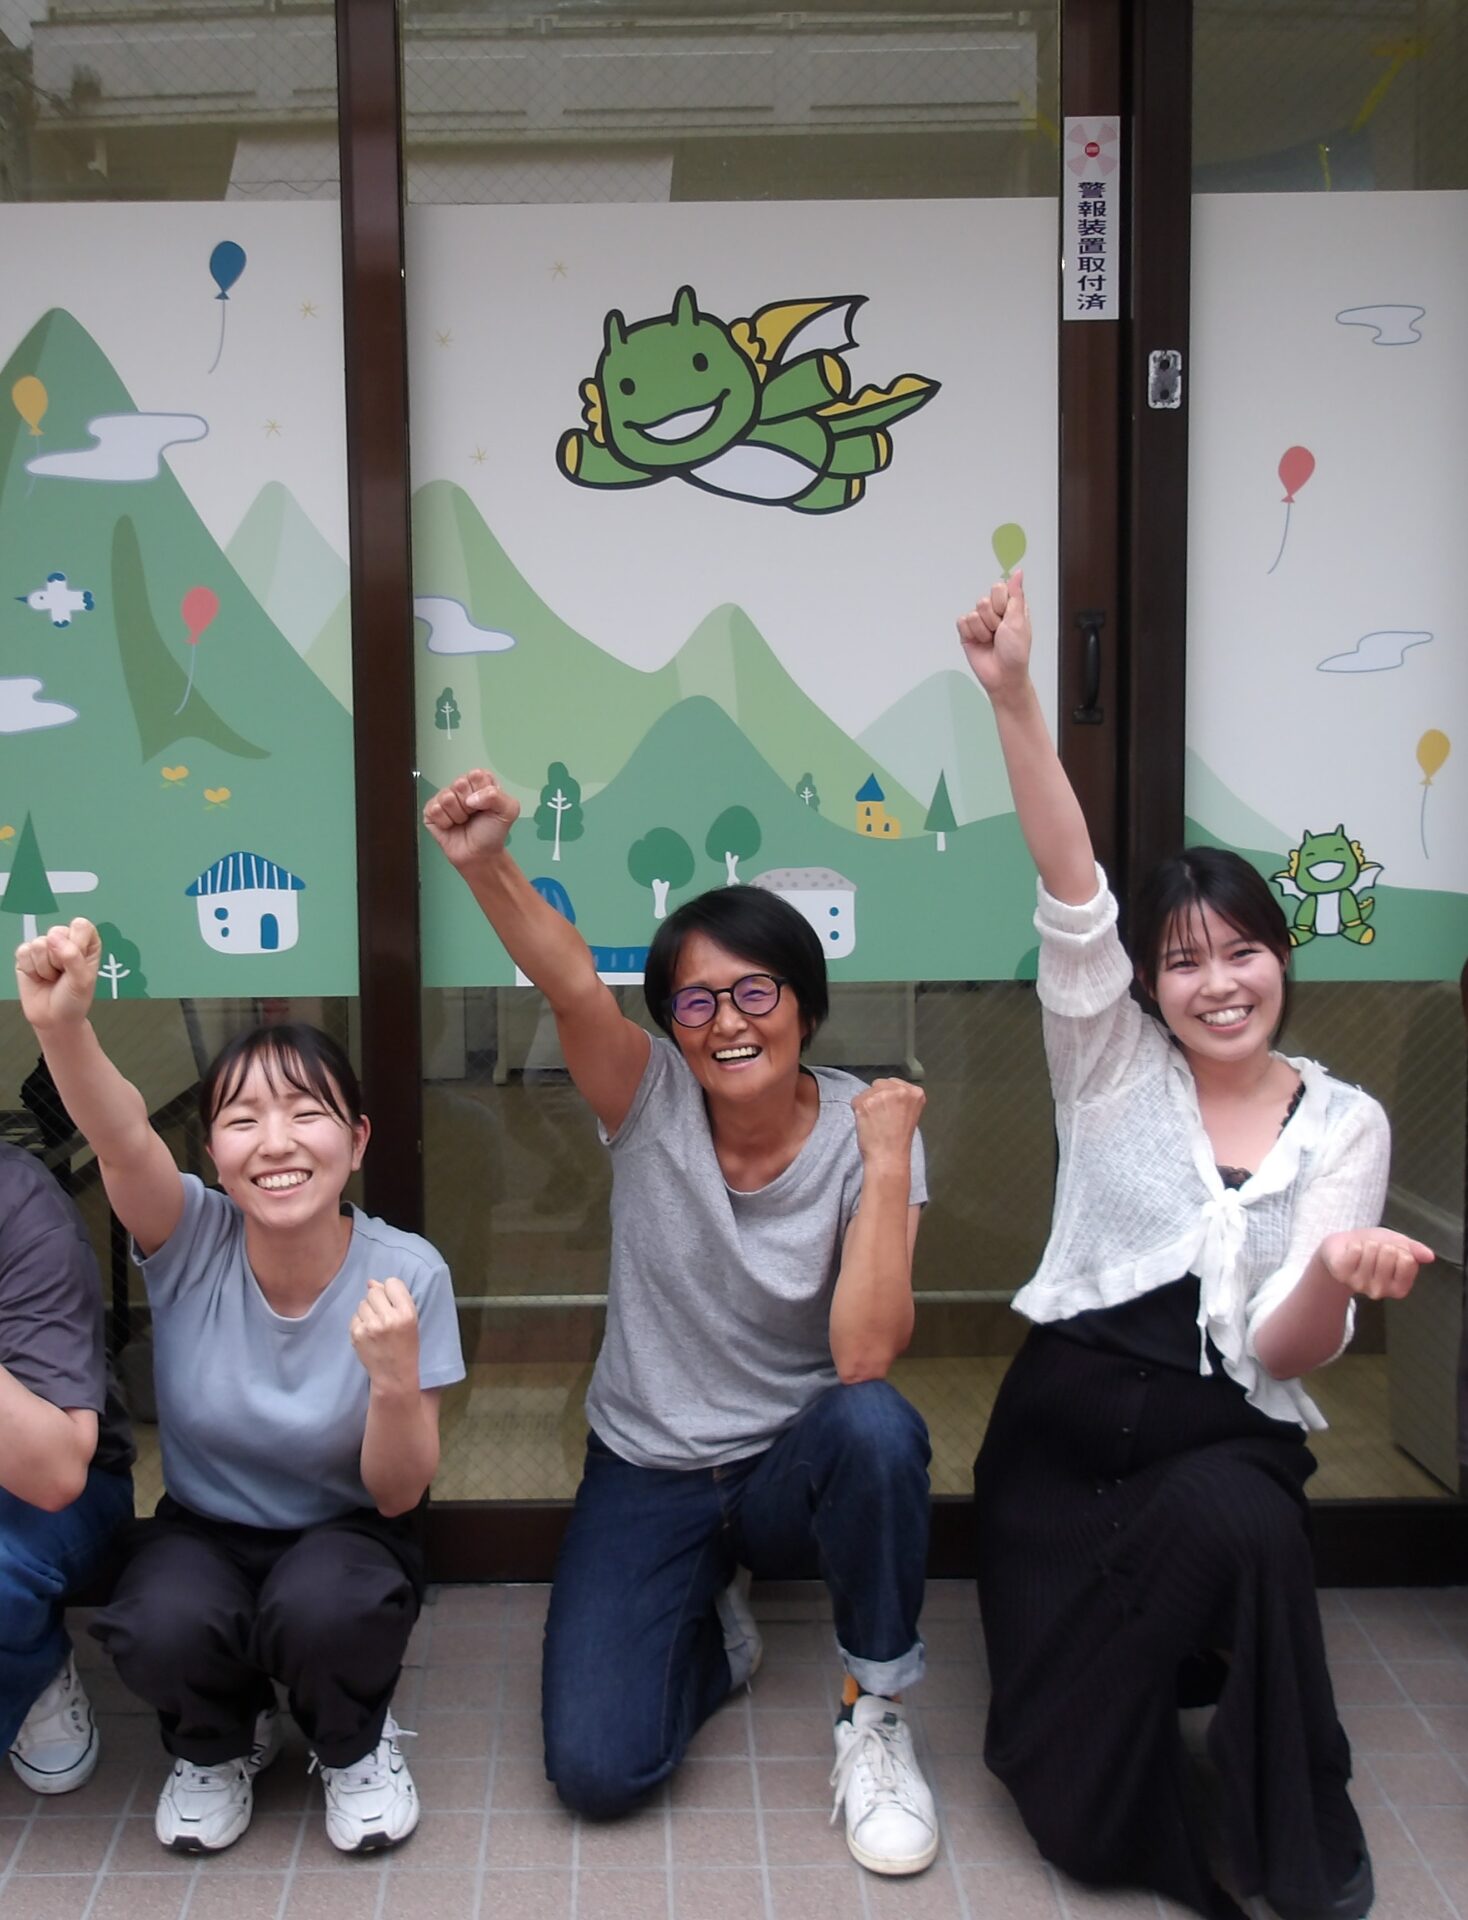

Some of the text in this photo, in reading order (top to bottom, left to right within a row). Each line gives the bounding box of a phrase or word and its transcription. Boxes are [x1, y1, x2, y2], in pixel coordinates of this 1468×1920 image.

[1077, 181, 1107, 311] 警報装置取付済
